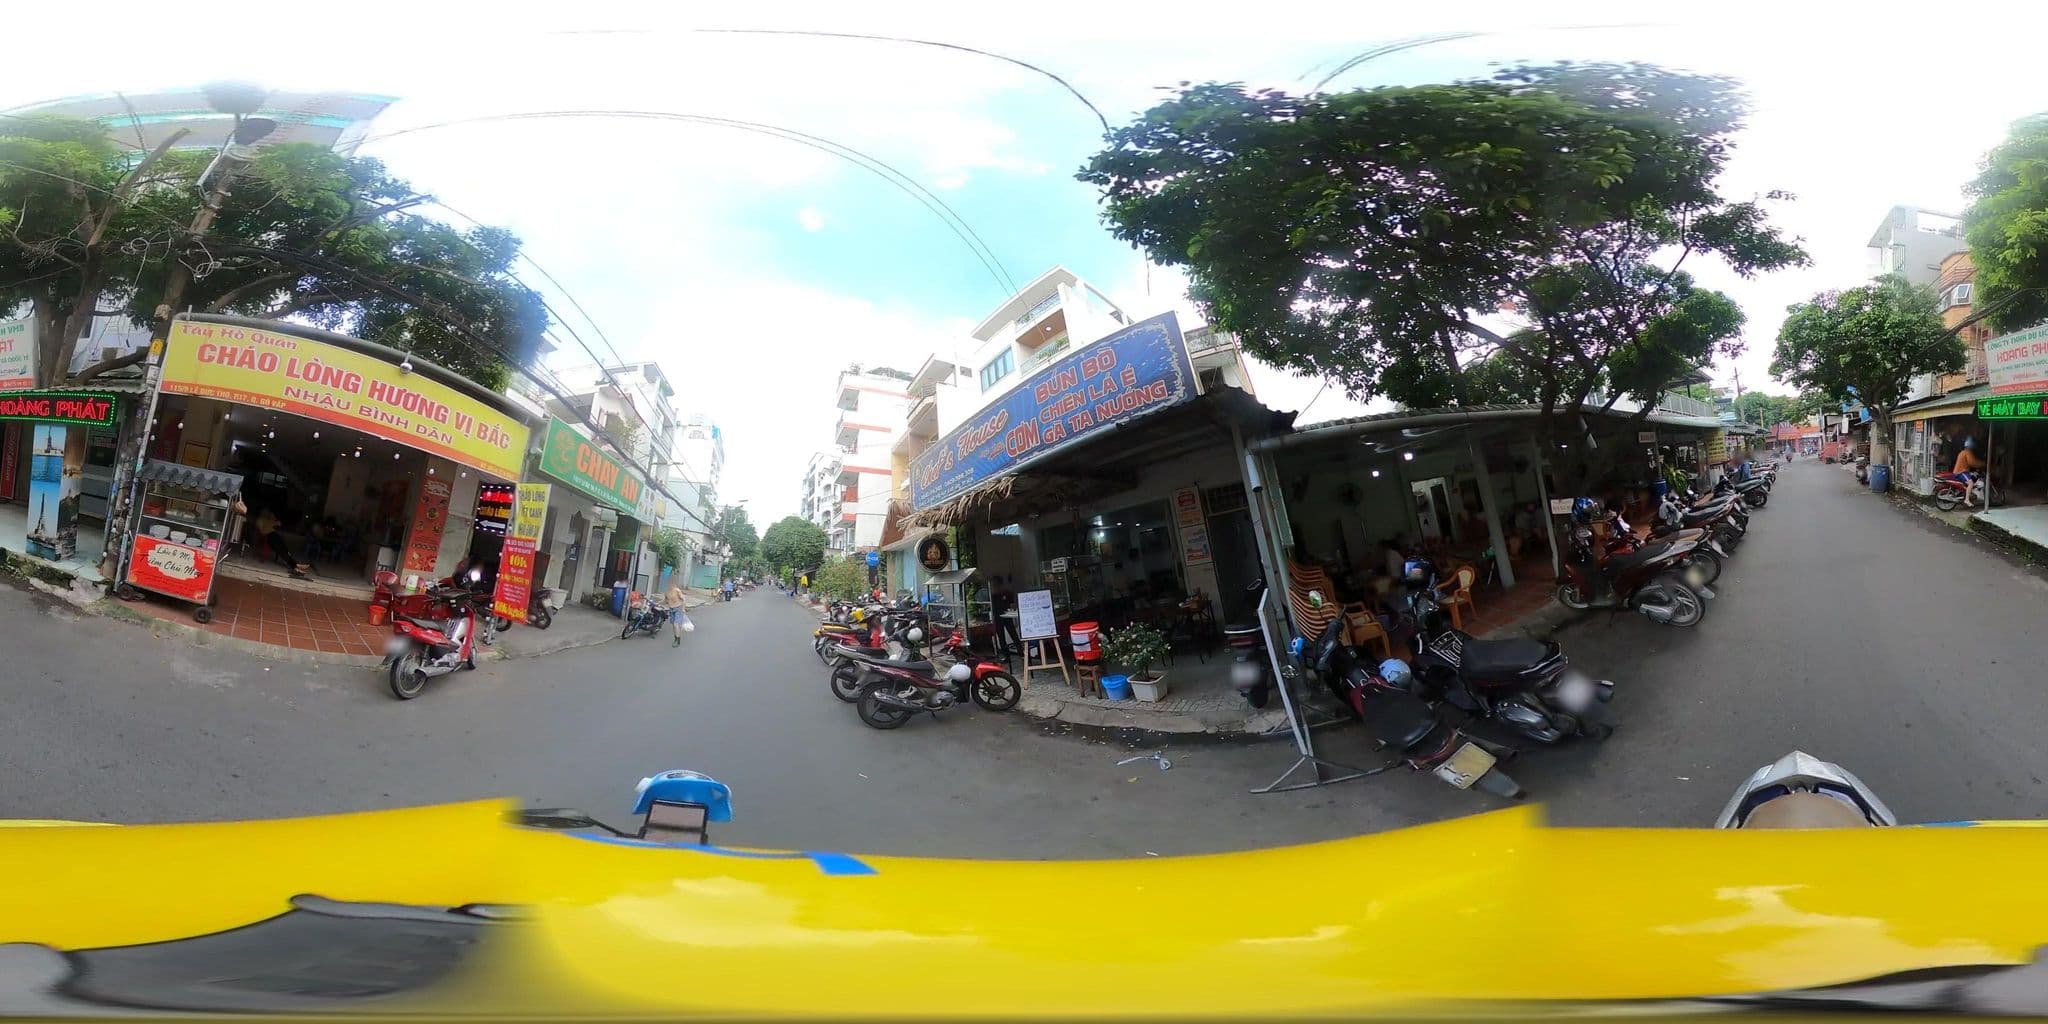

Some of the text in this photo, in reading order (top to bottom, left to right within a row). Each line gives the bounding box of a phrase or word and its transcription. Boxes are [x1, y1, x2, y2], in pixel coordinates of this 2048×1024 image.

[197, 343, 280, 373] CHÁO
[285, 357, 362, 395] LÒNG
[368, 379, 450, 425] HƯƠNG
[454, 411, 473, 438] VỊ
[476, 423, 511, 450] BẮC
[1035, 346, 1117, 405] BÚN BÒ
[1040, 363, 1137, 424] CHIÊN LÁ É
[55, 397, 110, 420] PHÁT
[284, 386, 453, 445] NHẬU BÌNH DÂN
[957, 409, 1009, 461] House
[1005, 417, 1041, 457] CƠM
[1043, 380, 1168, 444] GÀ TA NƯỚNG
[2018, 401, 2040, 416] BAY
[576, 443, 620, 490] CHAY
[620, 475, 639, 503] AN
